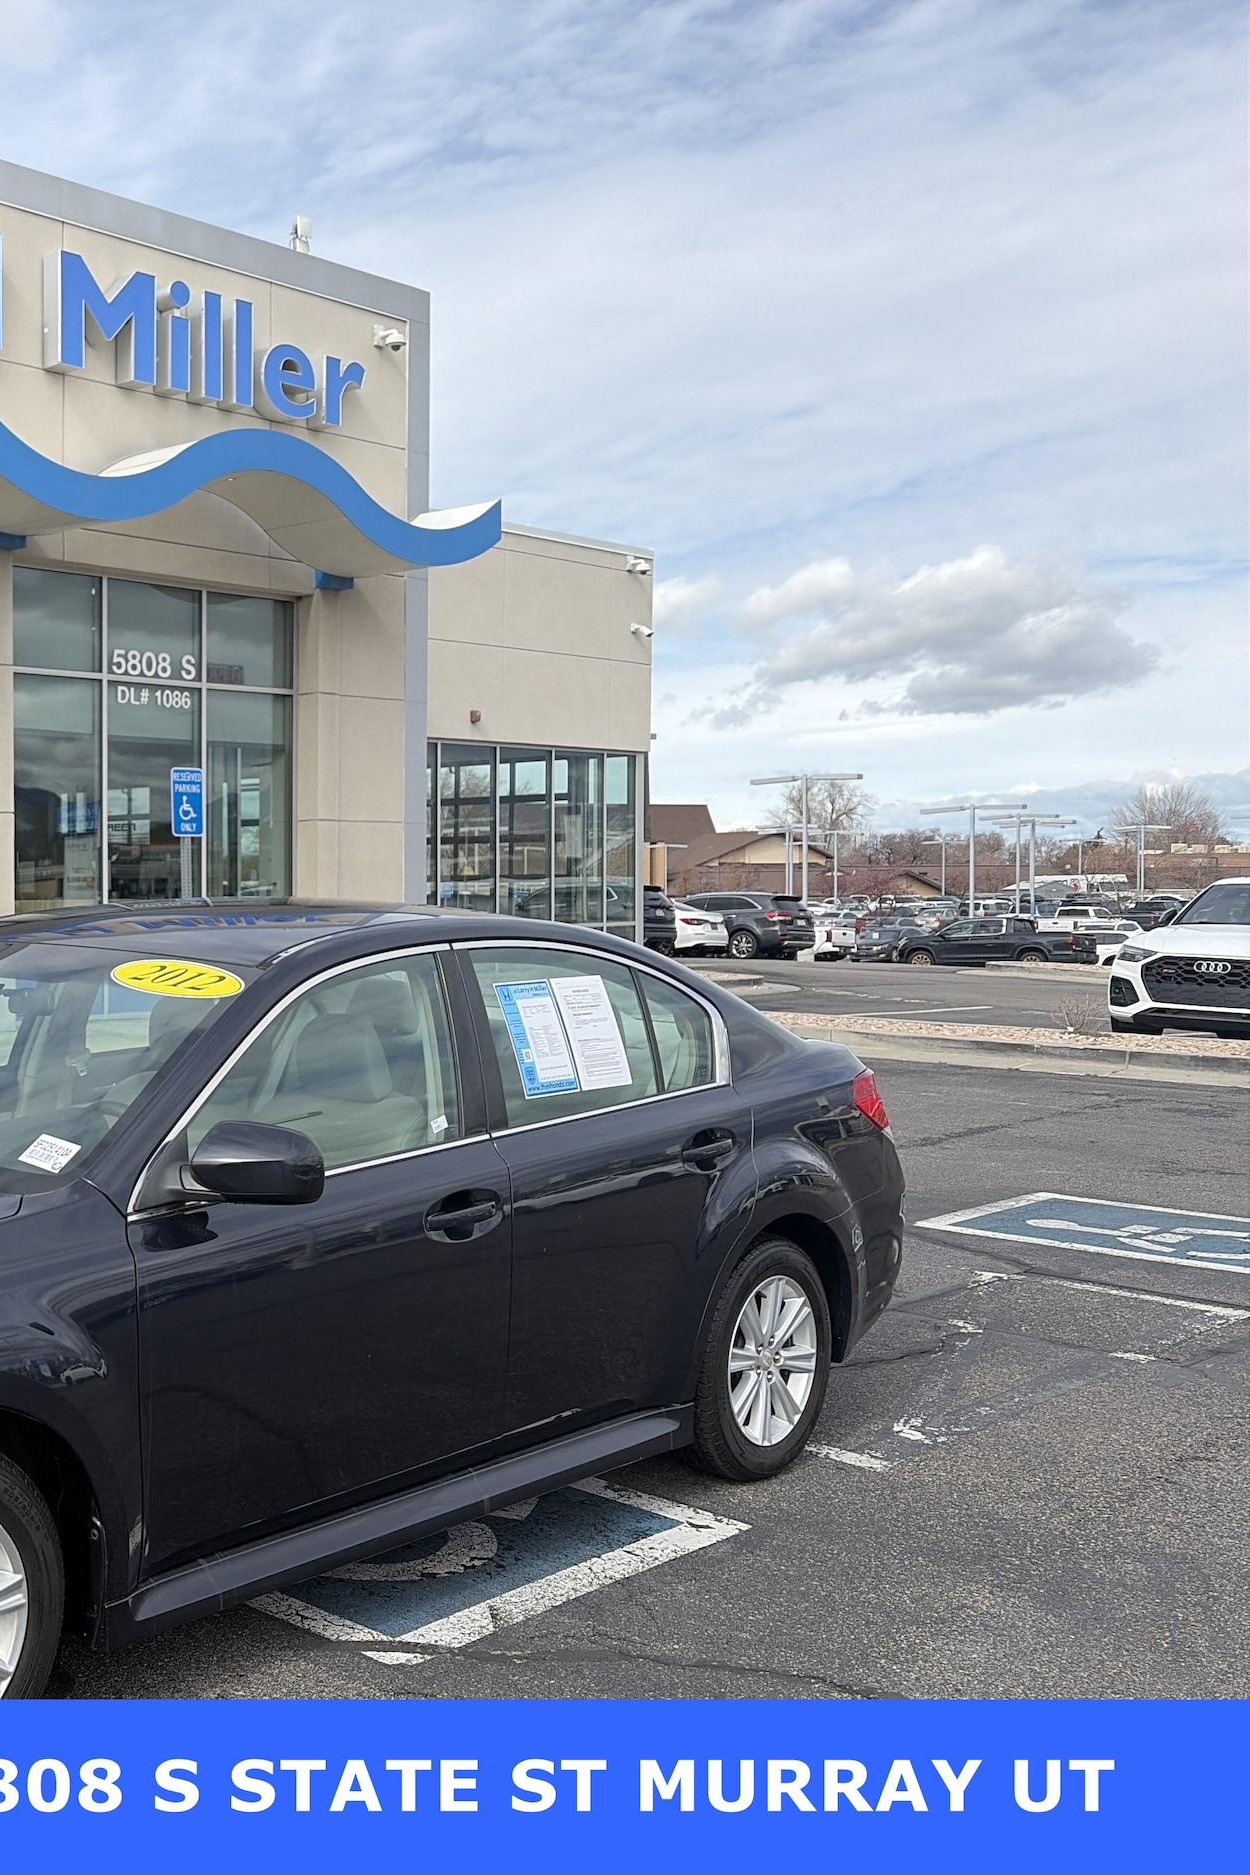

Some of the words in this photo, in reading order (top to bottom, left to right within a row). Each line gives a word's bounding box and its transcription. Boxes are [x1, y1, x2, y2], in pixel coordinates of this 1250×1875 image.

[52, 249, 367, 429] Miller
[111, 648, 172, 678] 5808
[180, 654, 197, 680] S
[116, 685, 150, 705] DL#
[154, 689, 192, 709] 1086
[173, 771, 202, 783] RESERVED
[174, 783, 201, 794] PARKING
[180, 823, 197, 833] ONLY
[127, 965, 226, 991] 2012
